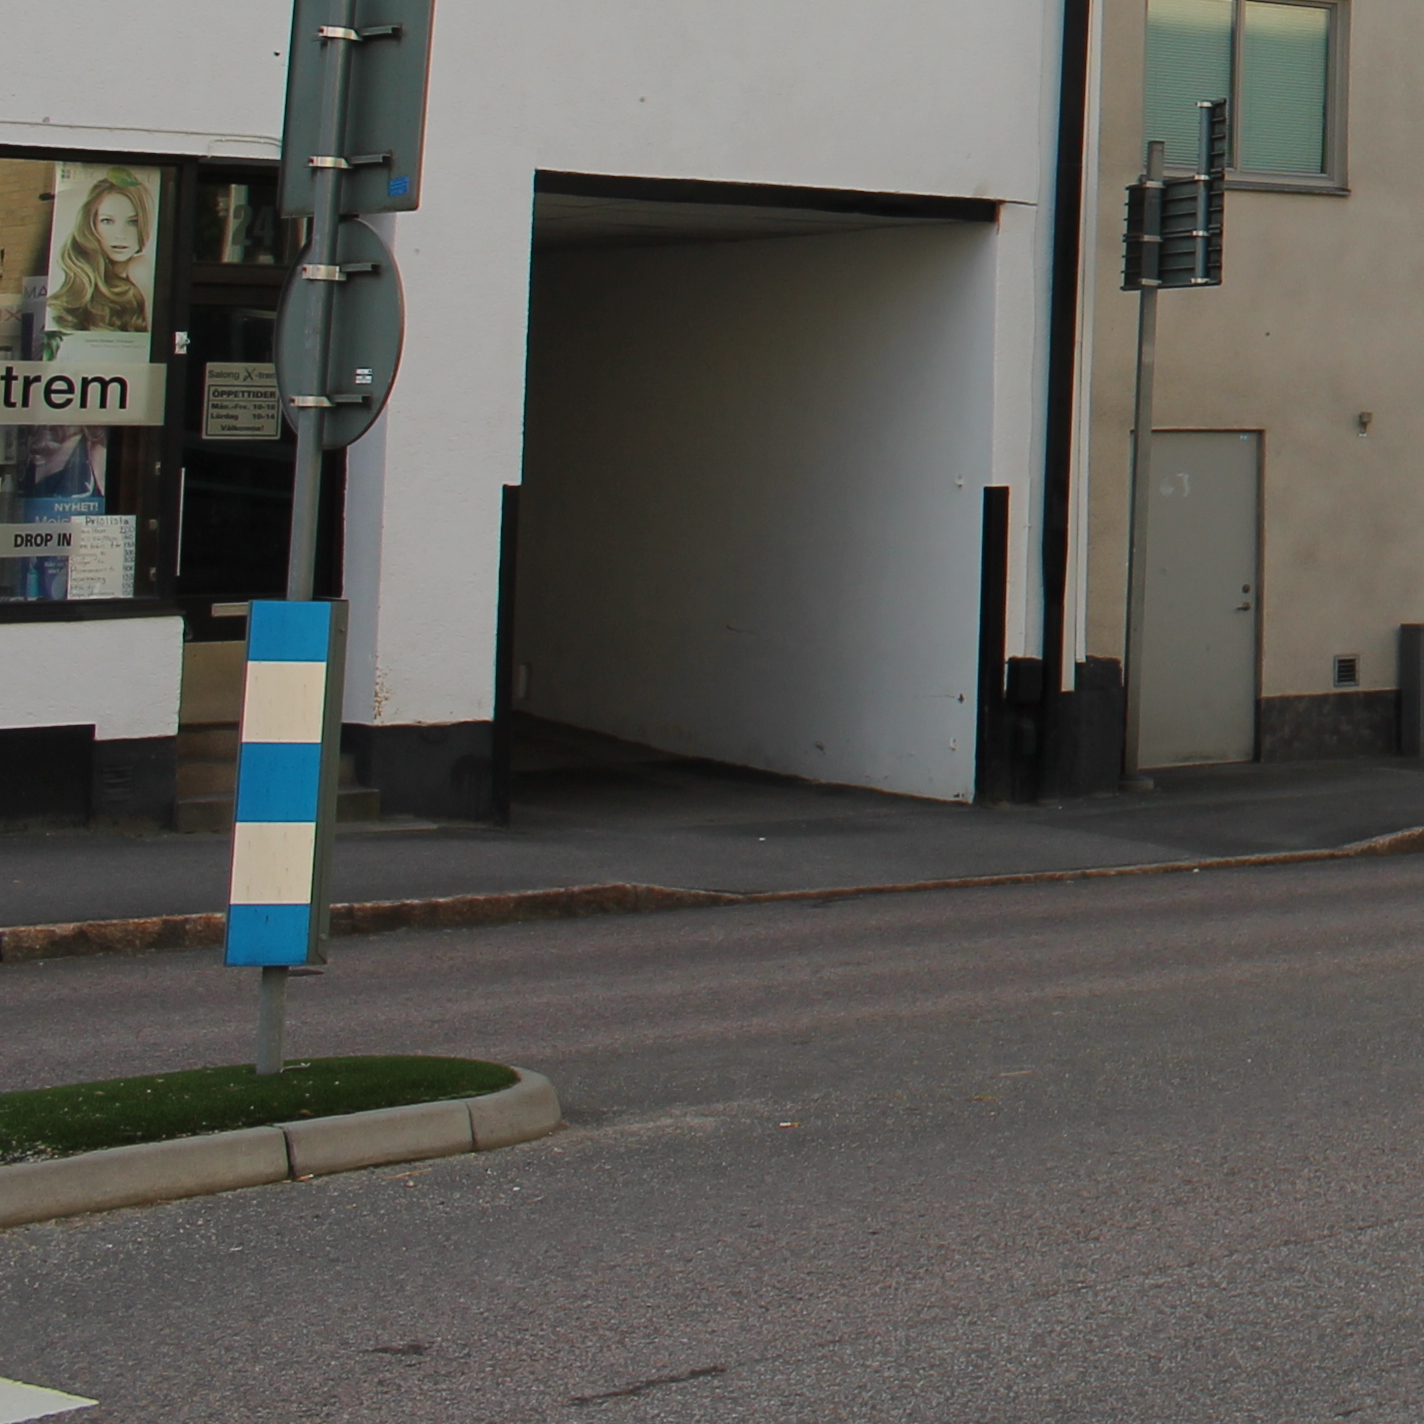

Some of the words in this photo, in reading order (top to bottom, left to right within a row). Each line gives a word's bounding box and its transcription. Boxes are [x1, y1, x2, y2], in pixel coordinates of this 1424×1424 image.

[231, 204, 274, 247] 24
[0, 366, 129, 410] trem
[212, 388, 277, 399] ÖPPETTIDER
[54, 502, 99, 512] NYHET!
[13, 533, 54, 548] DROP
[57, 533, 72, 547] IN
